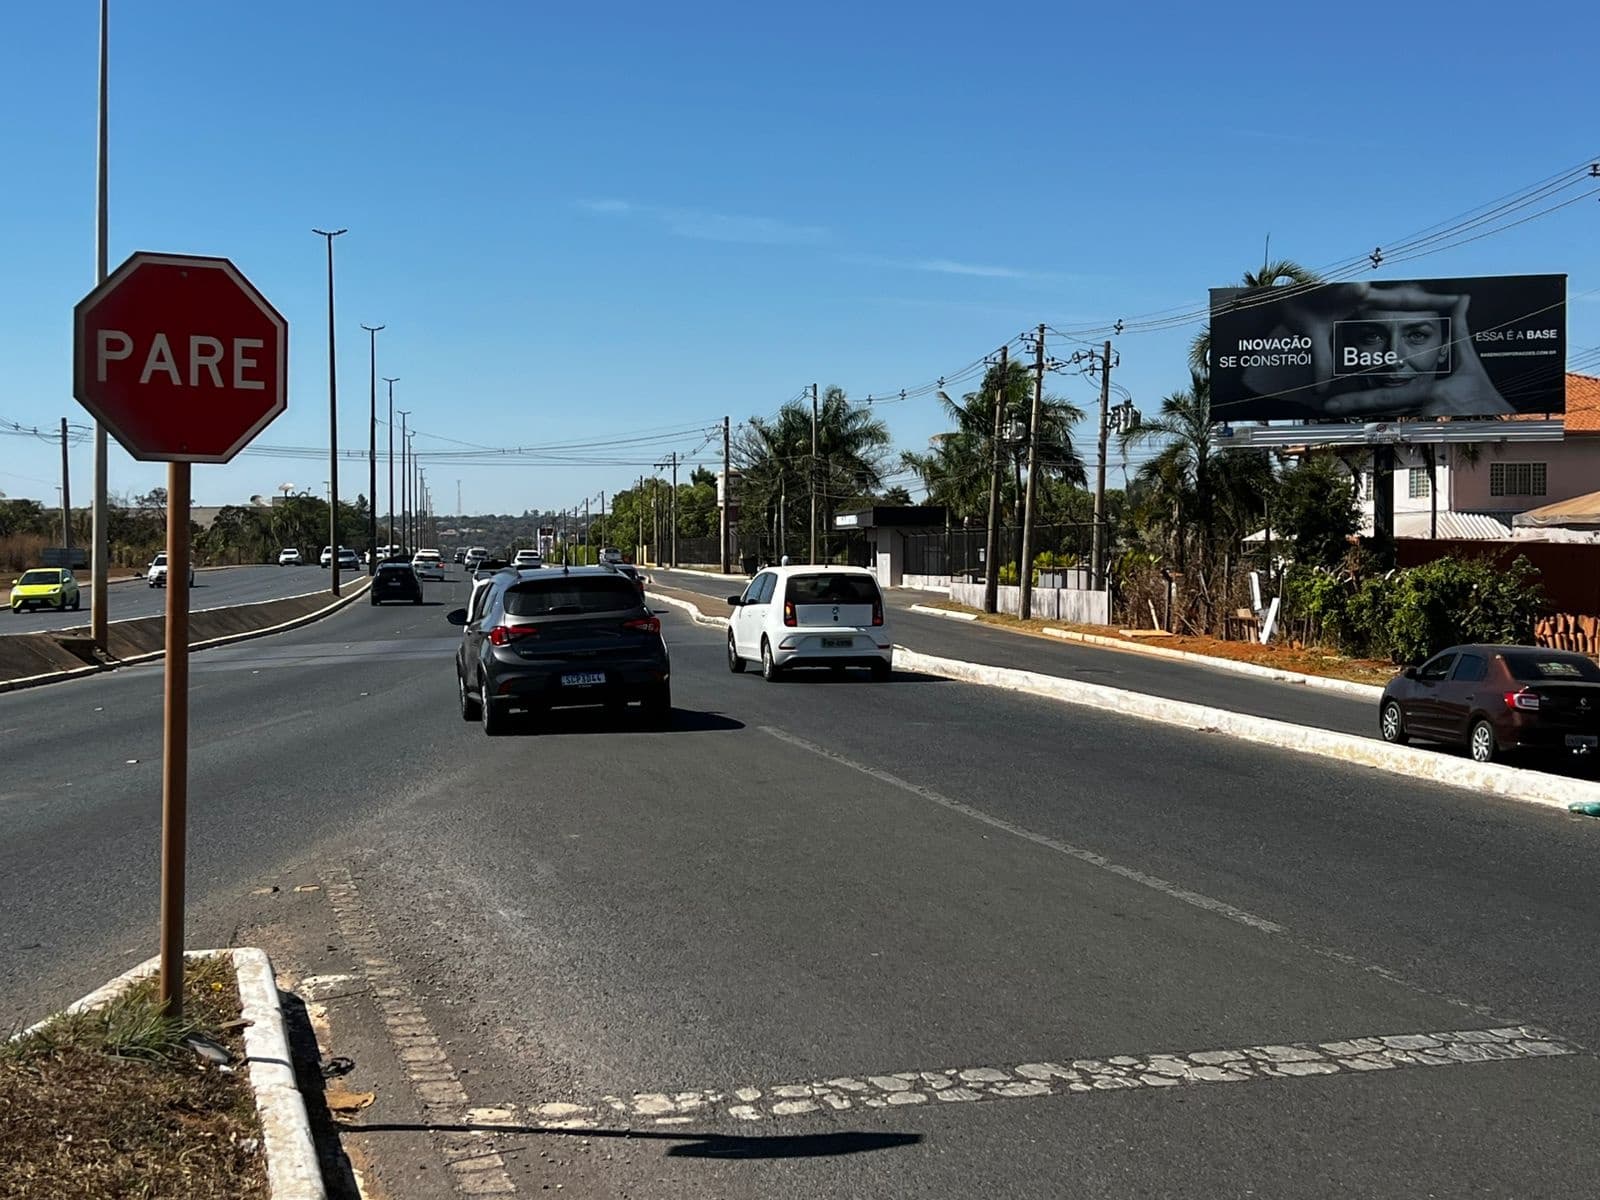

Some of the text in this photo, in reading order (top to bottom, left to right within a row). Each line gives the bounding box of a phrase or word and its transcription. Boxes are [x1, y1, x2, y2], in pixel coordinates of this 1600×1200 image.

[1239, 335, 1312, 351] INOVAÇÃO
[1475, 329, 1558, 342] ESSA É A BASE
[97, 329, 265, 390] PARE
[1219, 352, 1312, 368] SE CONSTRÓI
[1343, 346, 1404, 366] Base.
